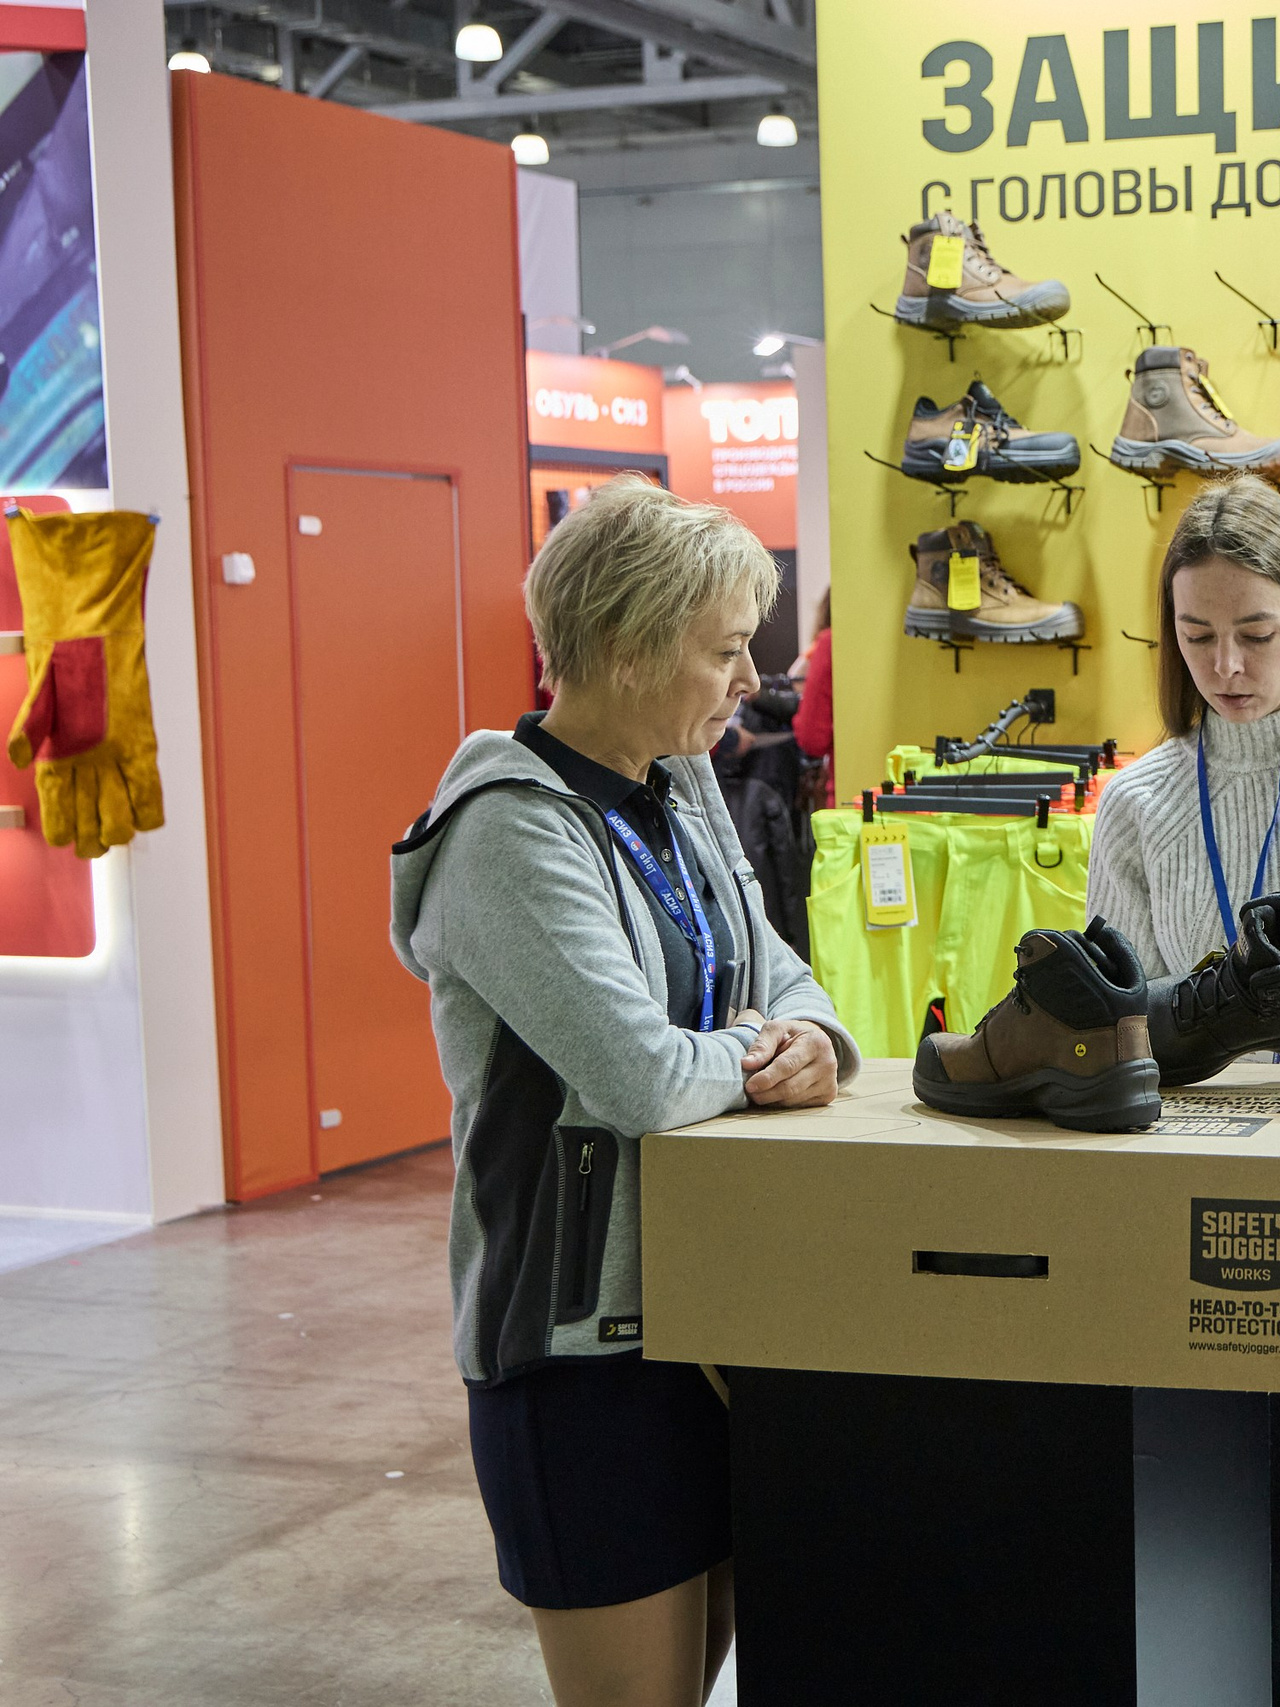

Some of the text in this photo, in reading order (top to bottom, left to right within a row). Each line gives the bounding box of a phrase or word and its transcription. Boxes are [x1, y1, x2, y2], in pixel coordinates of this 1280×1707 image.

[970, 165, 1193, 223] ГОЛОВЫ
[535, 388, 600, 422] ОБУВЬ
[609, 815, 632, 838] АСИЗ
[662, 891, 682, 915] АСИЗ
[703, 932, 714, 958] АСИЗ
[1221, 1267, 1271, 1281] WORKS
